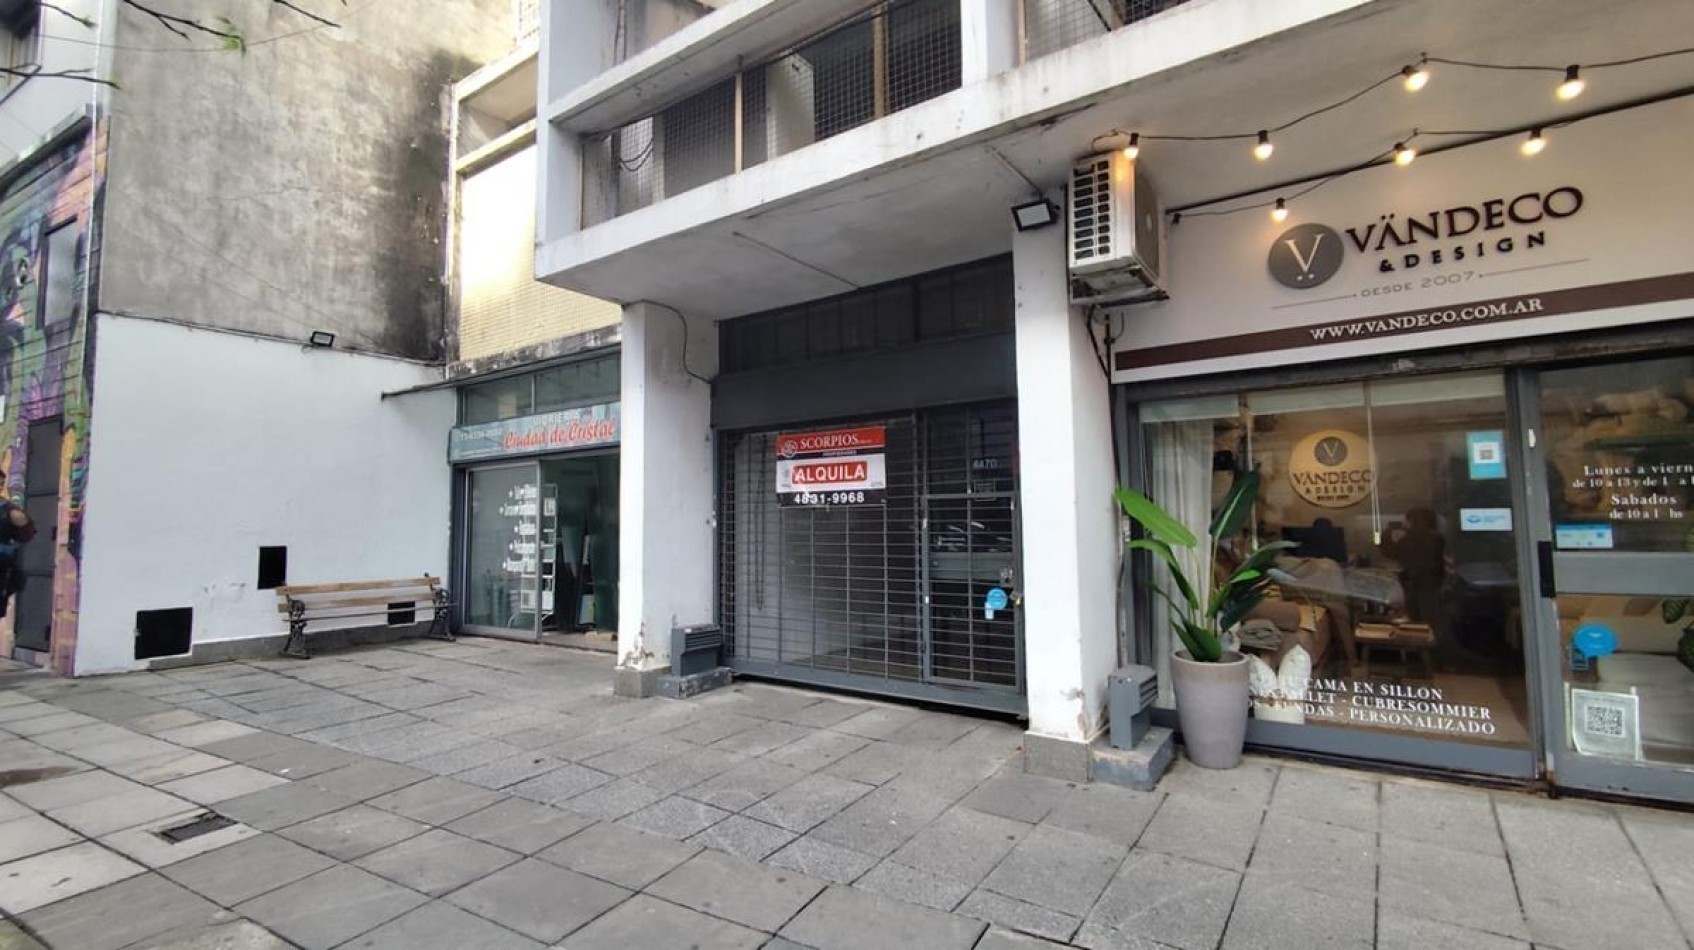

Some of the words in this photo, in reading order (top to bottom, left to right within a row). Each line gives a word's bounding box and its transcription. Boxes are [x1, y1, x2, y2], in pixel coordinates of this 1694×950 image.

[1345, 186, 1584, 253] VÄNDECO
[1361, 281, 1414, 298] DESDE
[1421, 270, 1475, 289] 2007
[1310, 298, 1544, 340] WWW.VANDECO.COM.AR
[504, 427, 546, 449] Ciudad
[551, 426, 566, 443] de
[569, 417, 614, 441] Cristal
[800, 434, 859, 450] SCORPIOS
[794, 463, 865, 483] ALQUILA
[1584, 465, 1632, 476] Lunes
[1637, 466, 1645, 475] a
[794, 491, 865, 505] 4831-9968
[1611, 492, 1678, 505] Sabados
[1353, 681, 1375, 694] EN
[1379, 682, 1443, 701] SILLON
[1351, 694, 1492, 721] CUBRESOMMIER
[1349, 708, 1496, 735] PERSONALIZADO
